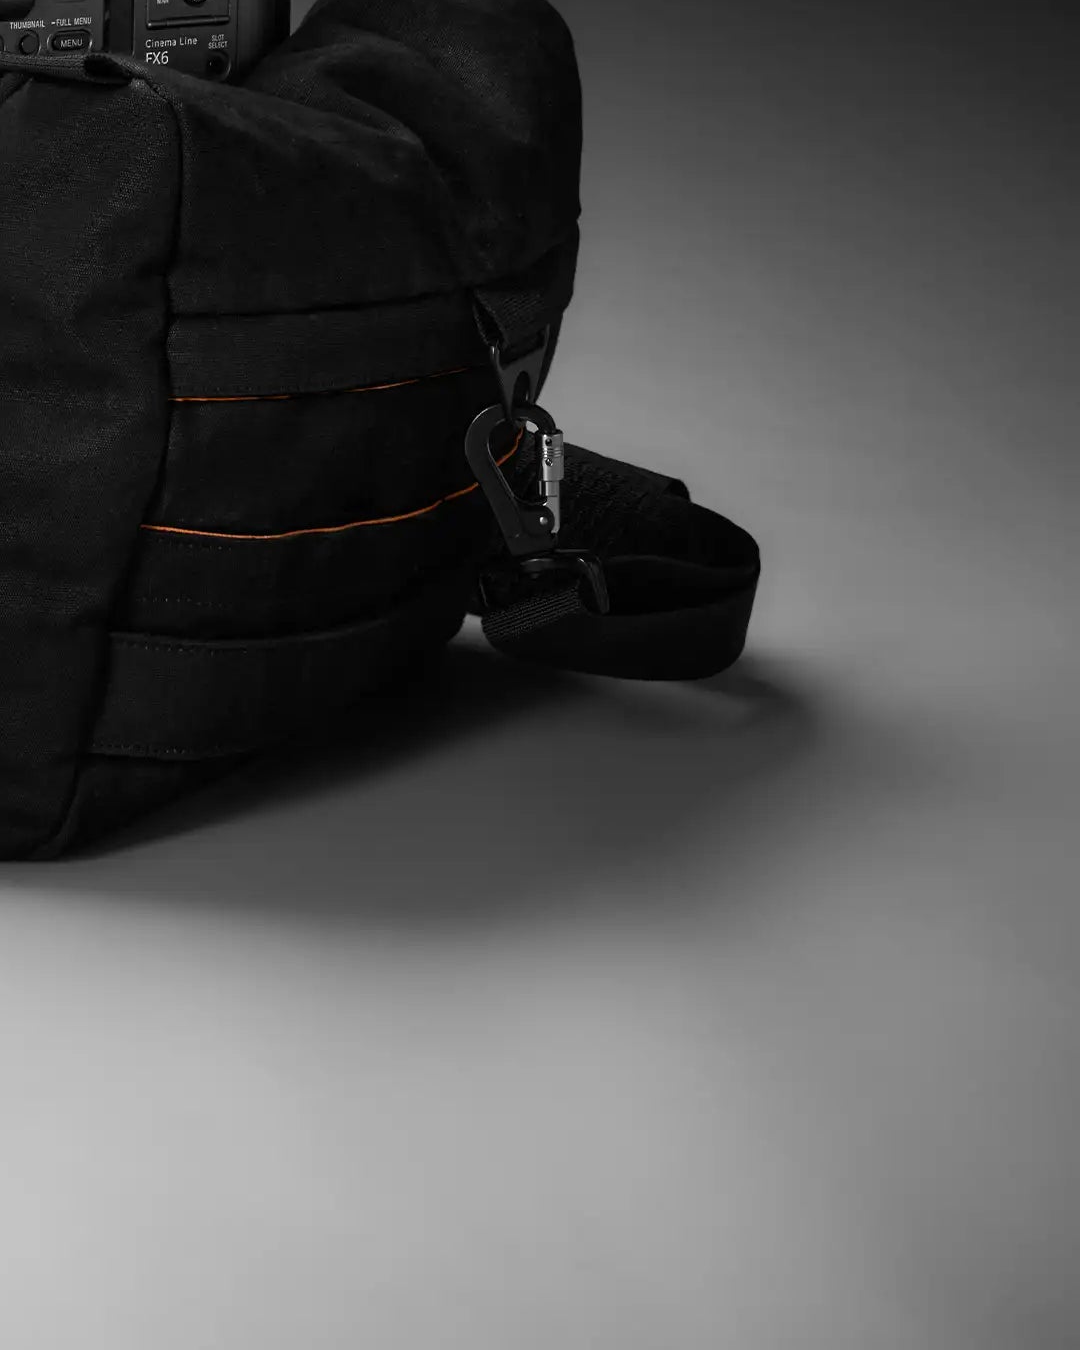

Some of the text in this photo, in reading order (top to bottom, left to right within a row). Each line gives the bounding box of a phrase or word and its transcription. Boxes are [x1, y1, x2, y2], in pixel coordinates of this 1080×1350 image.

[10, 21, 46, 30] THUMBNAIL
[74, 17, 92, 25] MENU
[60, 39, 83, 48] MENU
[145, 36, 198, 48] Cinema Line
[208, 40, 228, 48] SELECT
[146, 52, 169, 65] FX6
